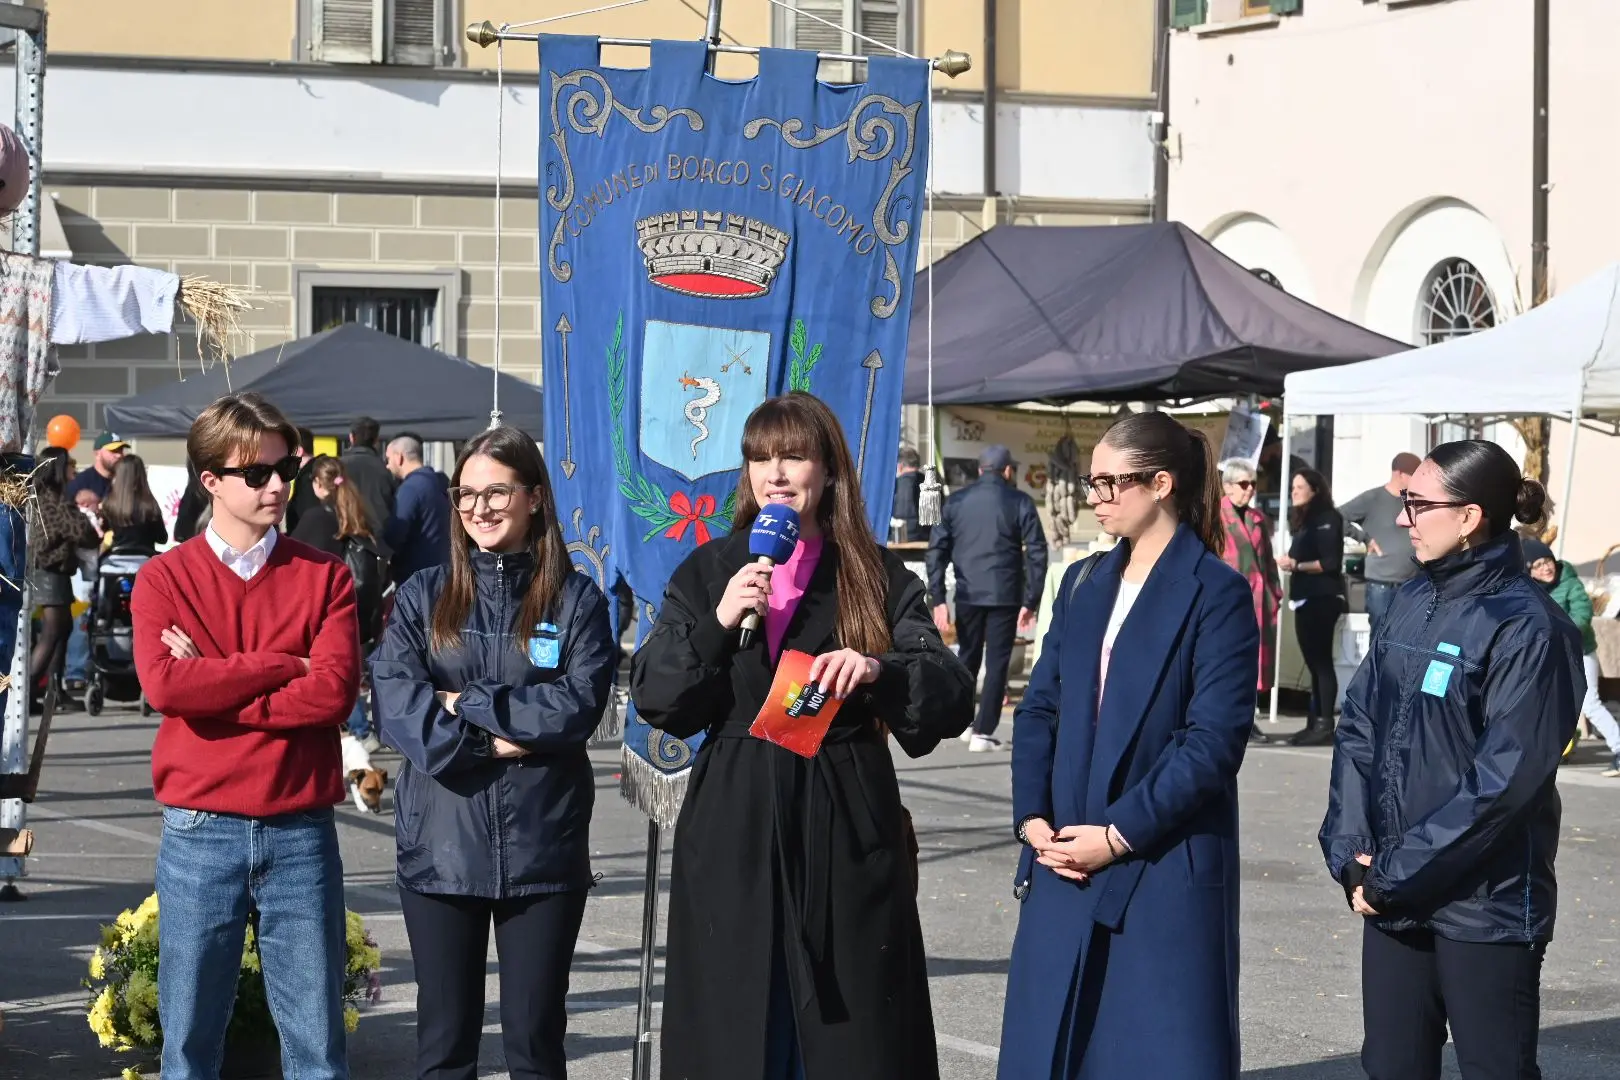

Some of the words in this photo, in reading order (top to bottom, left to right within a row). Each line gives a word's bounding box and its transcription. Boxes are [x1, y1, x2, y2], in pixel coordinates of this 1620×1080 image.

[565, 163, 644, 237] COMUNE
[644, 162, 658, 184] DI
[668, 153, 750, 186] BORGO
[788, 698, 805, 717] PIAZZA
[807, 692, 825, 710] NOI
